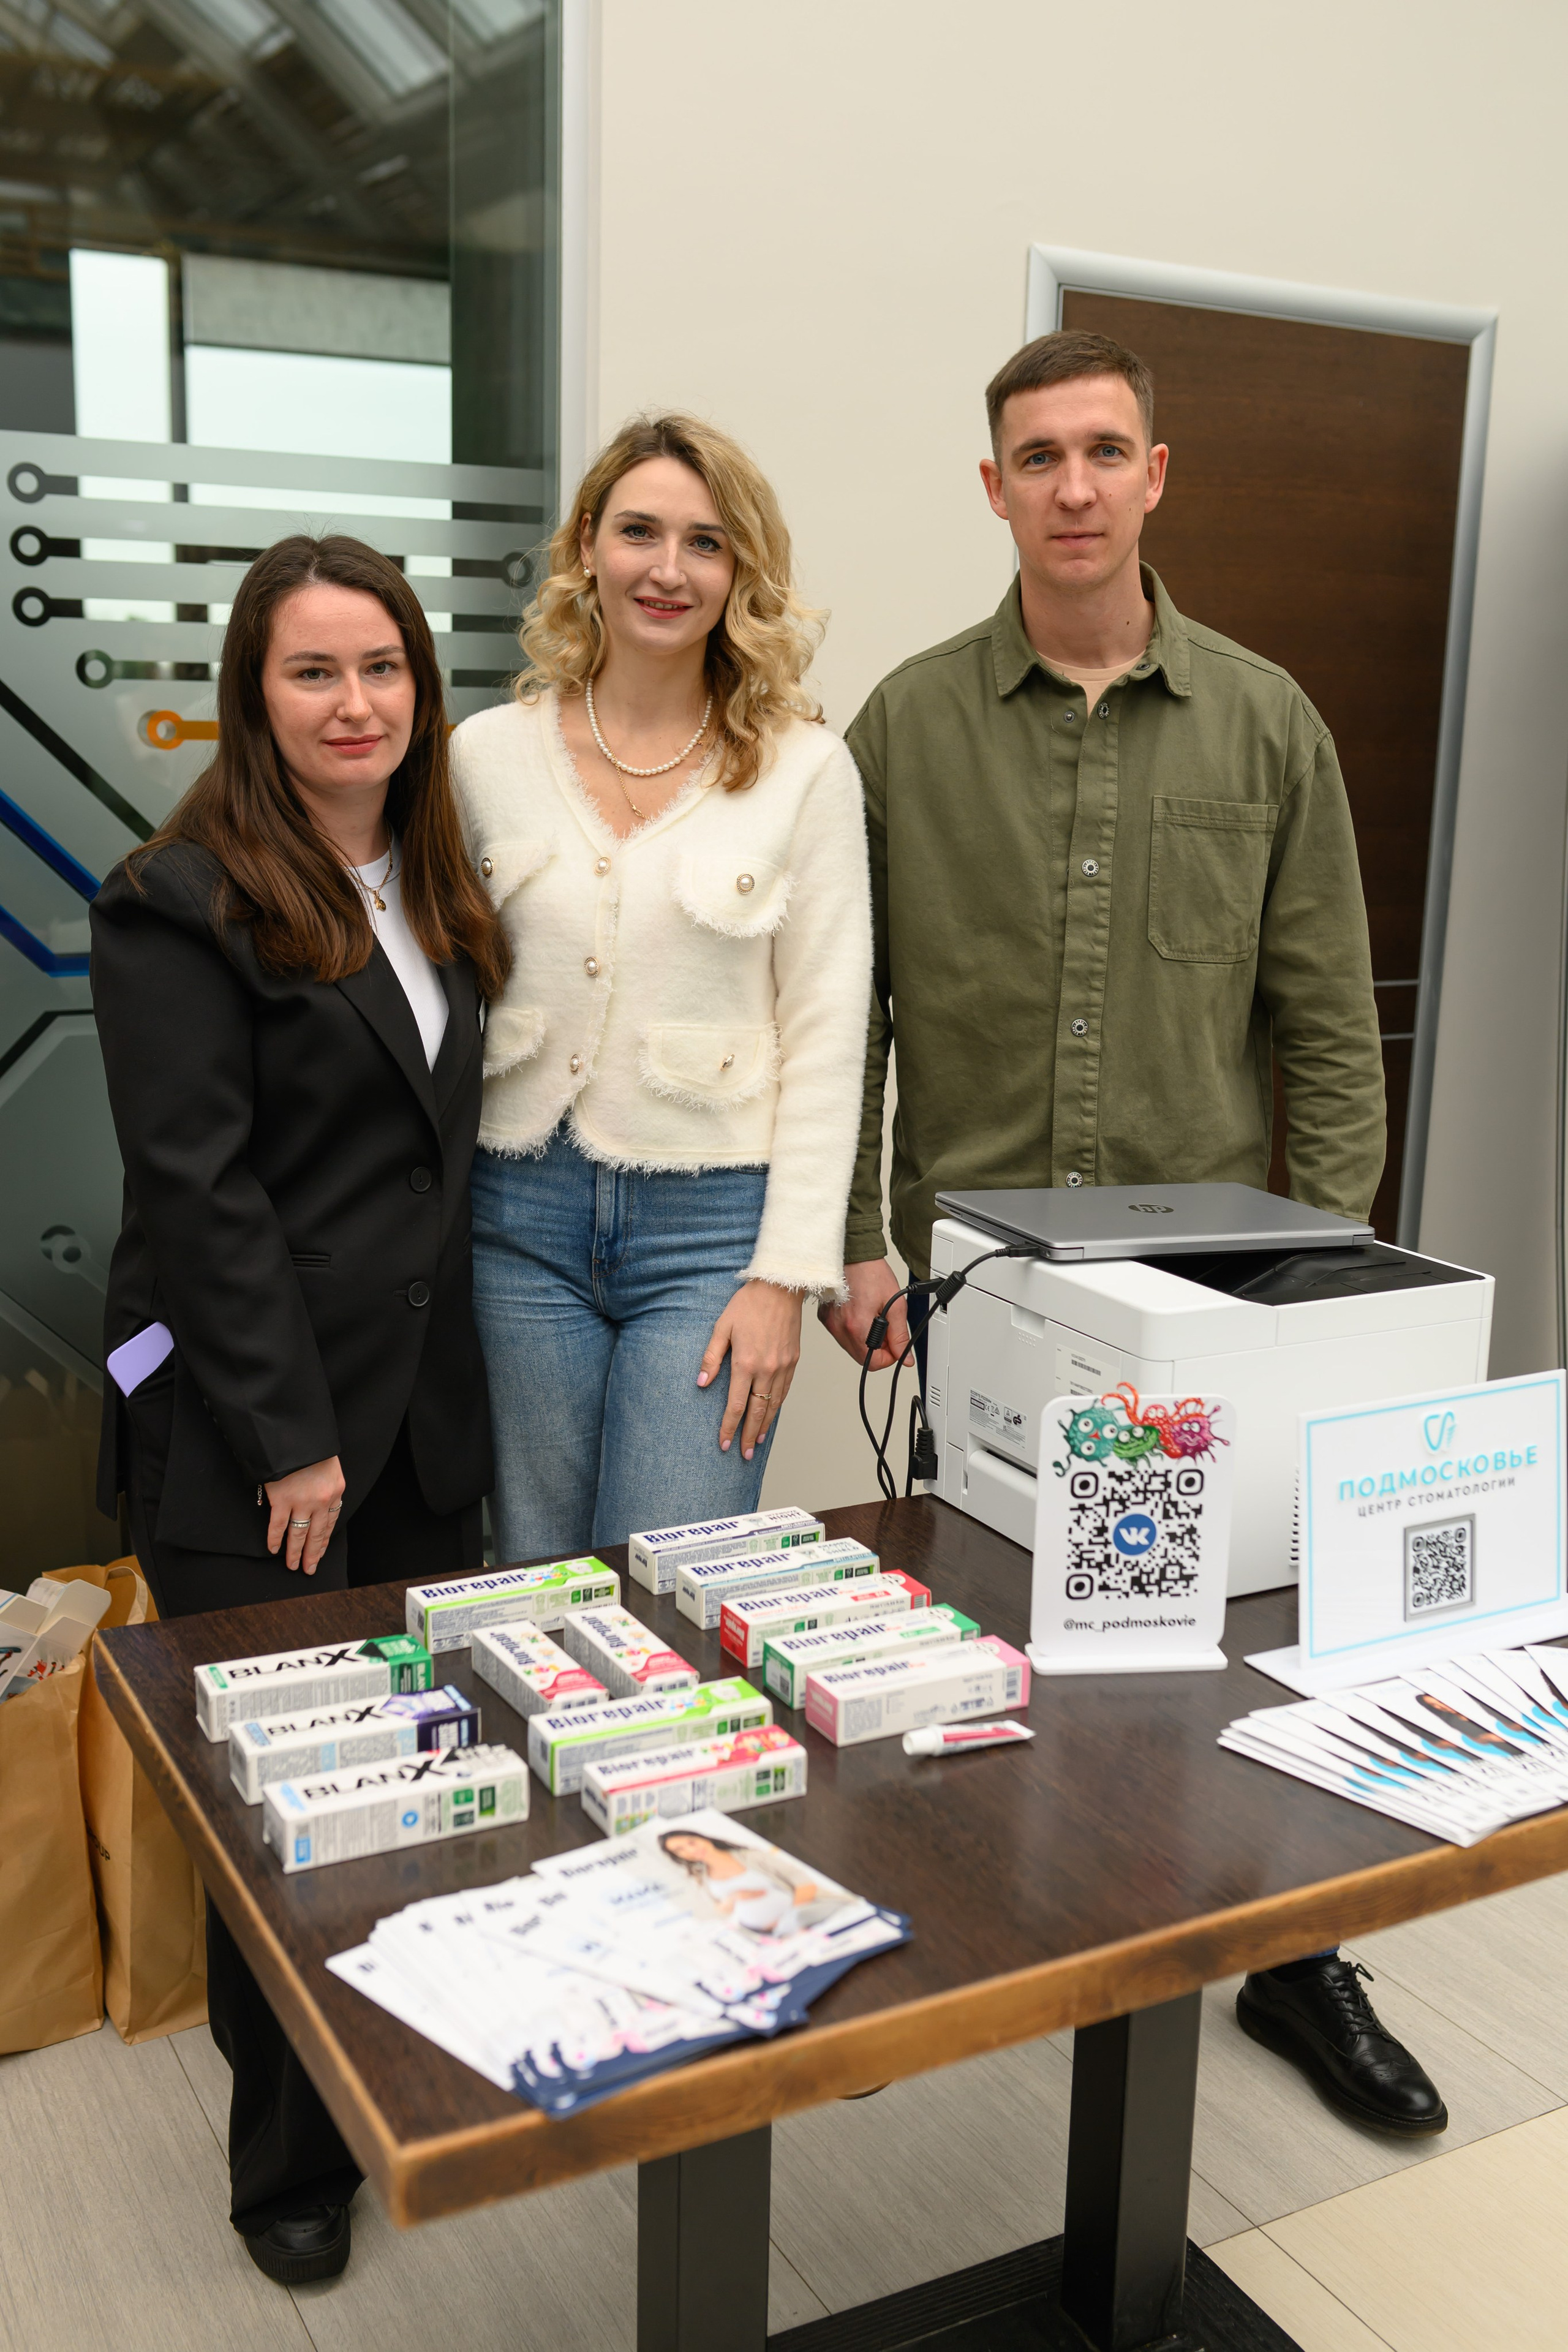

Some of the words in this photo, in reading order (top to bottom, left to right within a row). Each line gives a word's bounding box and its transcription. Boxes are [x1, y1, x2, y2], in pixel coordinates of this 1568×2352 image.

[1132, 1203, 1167, 1213] hp
[1338, 1445, 1538, 1501] ПОДМОСКОВЬЕ
[1357, 1499, 1401, 1517] ЦЕНТР
[1408, 1476, 1515, 1507] СТОМАТОЛОГИИ
[643, 1520, 739, 1544] Biorepair
[691, 1553, 791, 1576] Biorepair
[420, 1572, 528, 1599] Biorepair
[737, 1587, 840, 1611] Biorepair
[782, 1623, 888, 1649] Biorepair
[1063, 1615, 1196, 1633] @mc_podmoskovie
[228, 1648, 363, 1679] BLANX
[824, 1660, 910, 1684] Biorepair
[267, 1706, 385, 1736] BLANX
[546, 1698, 666, 1730] Biorepair
[597, 1749, 695, 1776] Biorepair
[304, 1759, 447, 1800] BLANX
